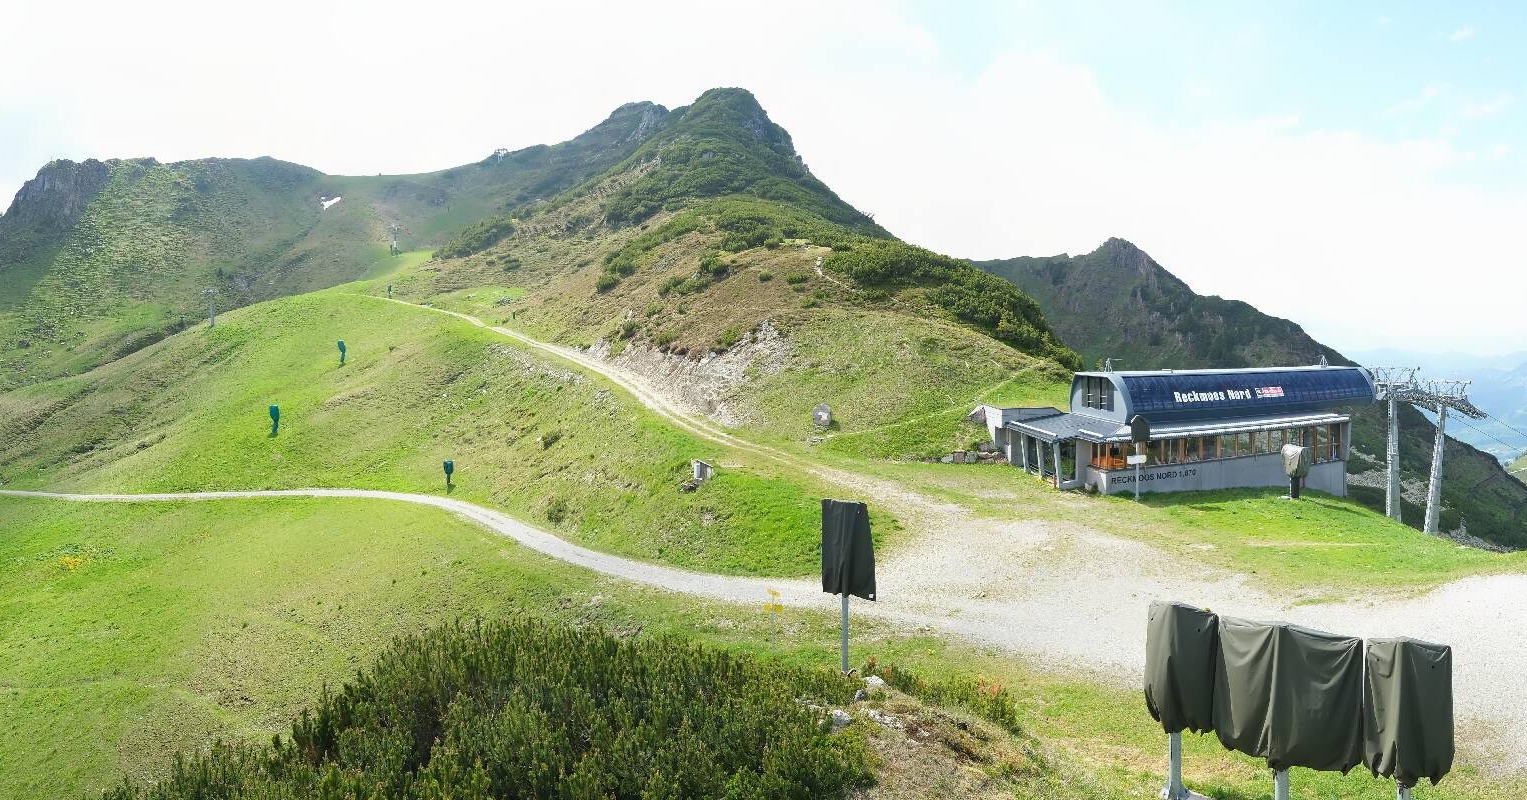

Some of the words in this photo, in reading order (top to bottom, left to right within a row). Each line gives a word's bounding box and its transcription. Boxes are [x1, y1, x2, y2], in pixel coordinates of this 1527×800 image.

[1174, 391, 1225, 402] Reckmoos
[1227, 389, 1251, 400] Nord
[1156, 471, 1178, 480] NORD
